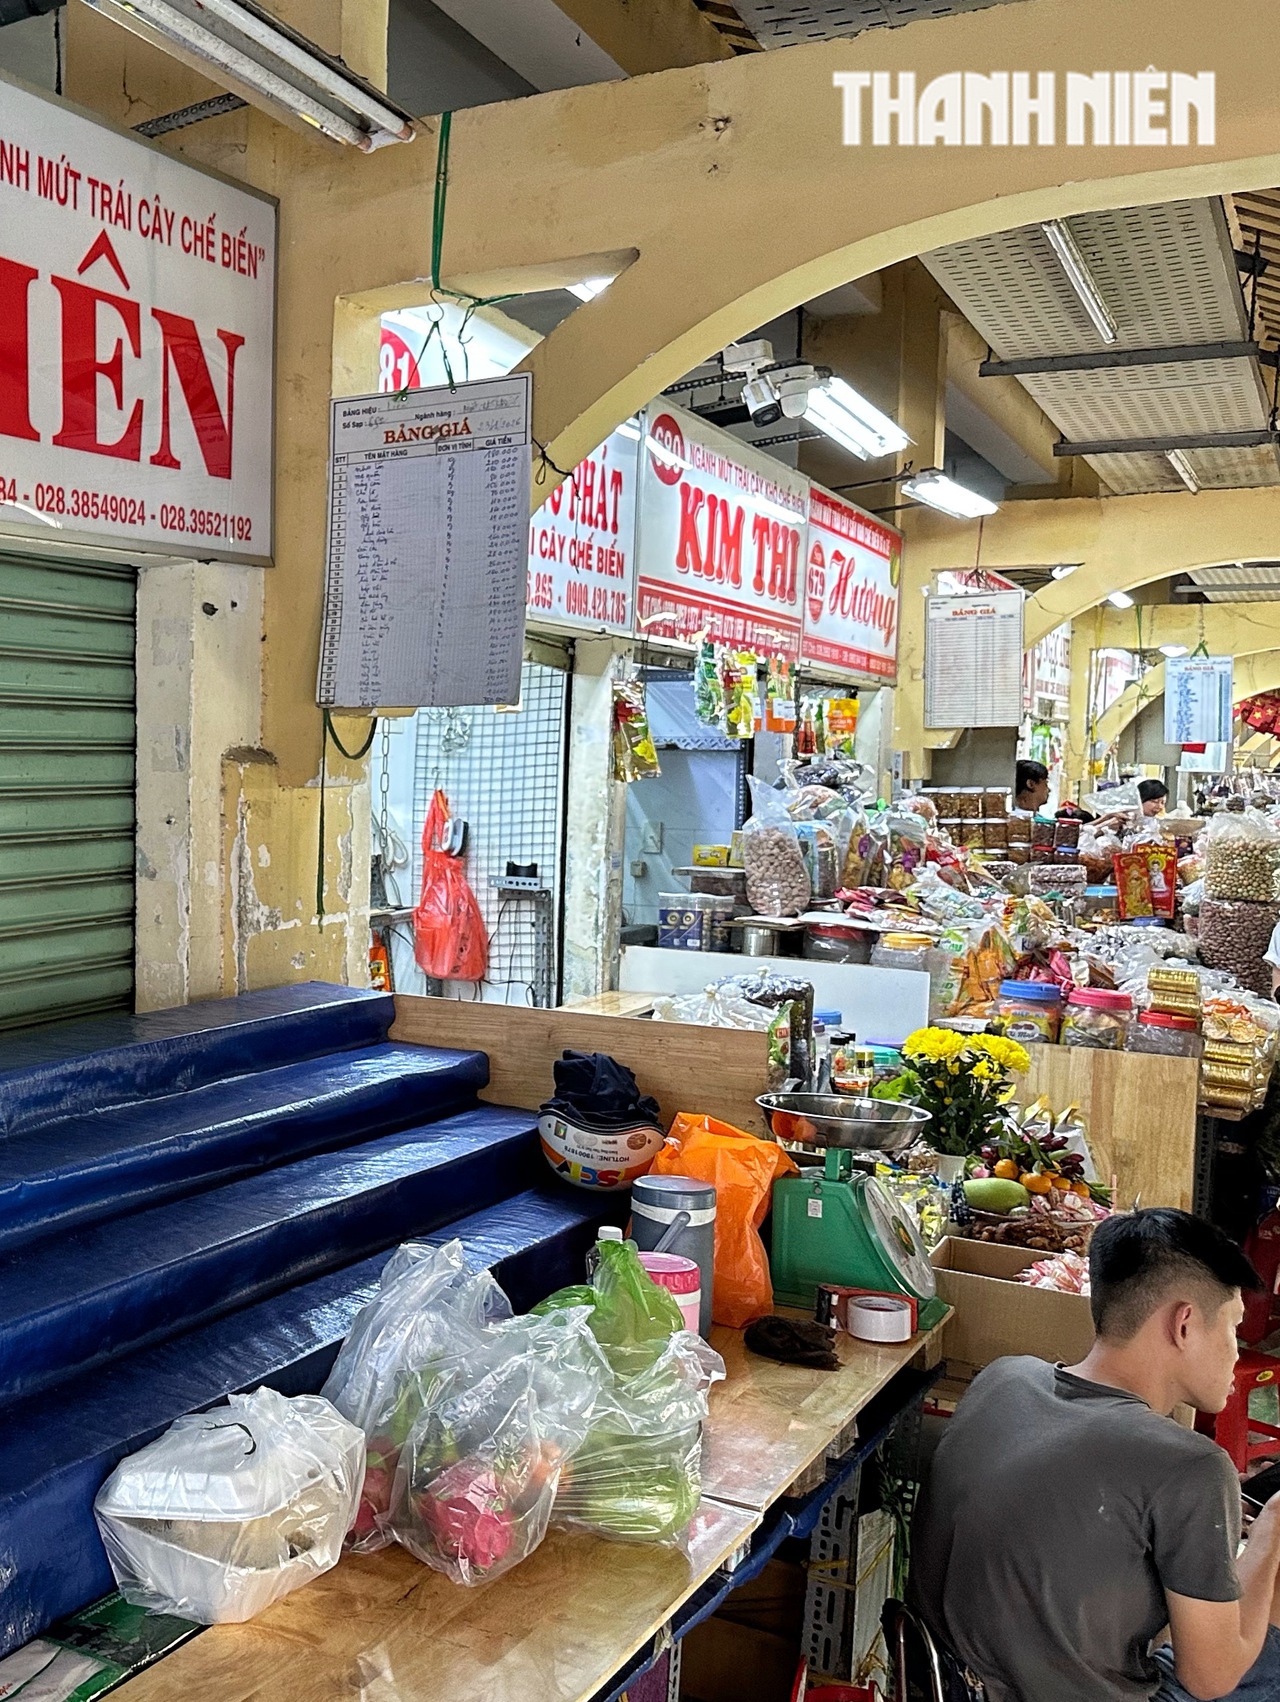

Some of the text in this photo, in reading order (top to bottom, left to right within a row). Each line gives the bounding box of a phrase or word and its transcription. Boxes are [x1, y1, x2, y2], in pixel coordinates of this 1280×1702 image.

[37, 154, 81, 211] MỨT
[88, 177, 132, 232] TRÁI
[138, 195, 176, 248] CÂY
[180, 212, 217, 264] CHẾ
[384, 423, 434, 445] BẢNG
[438, 416, 472, 438] GIÁ
[35, 483, 147, 527] 028.38549024
[160, 507, 253, 543] 028.39521192
[569, 445, 623, 535] PHÁT
[540, 525, 566, 563] CÂY
[569, 532, 595, 571] CHẾ
[596, 539, 625, 580] BIẾN
[676, 481, 745, 590] KIM
[751, 513, 800, 606] THI
[808, 566, 825, 597] 679
[829, 549, 896, 648] Hương
